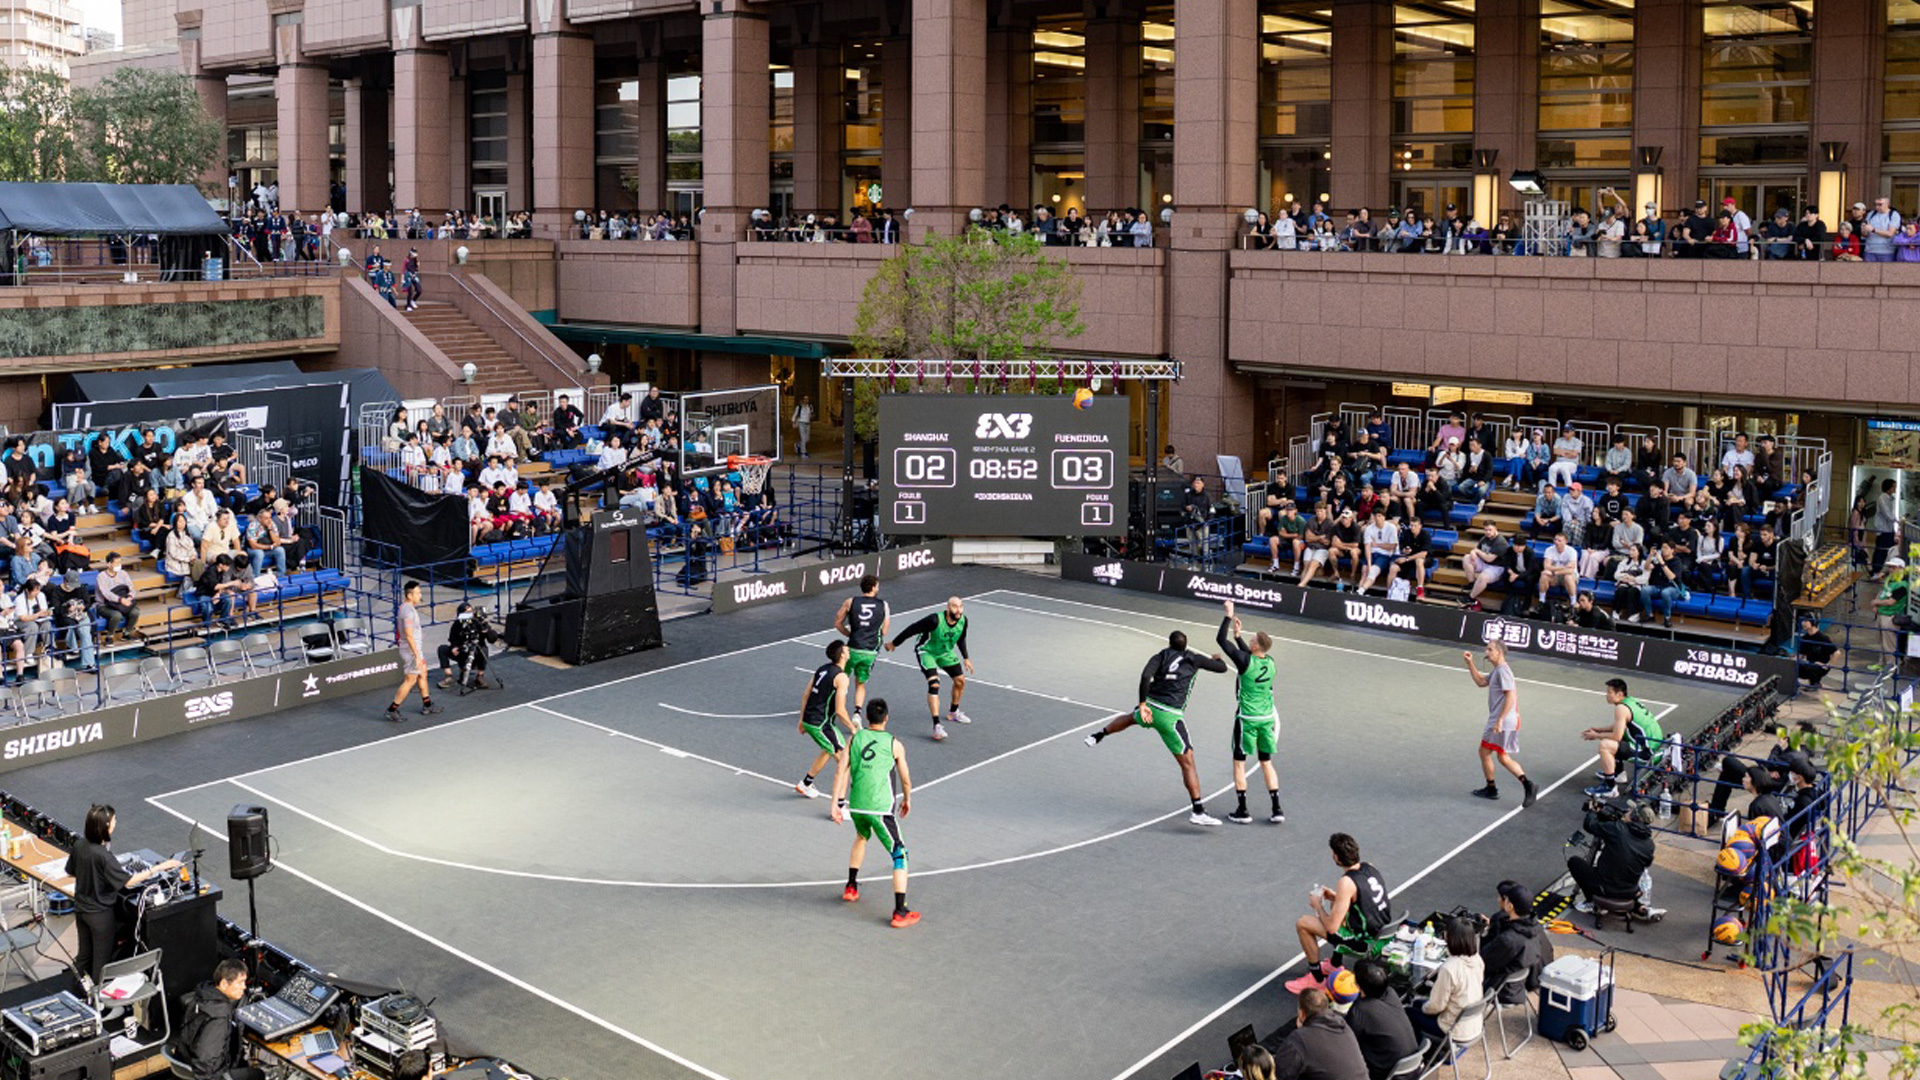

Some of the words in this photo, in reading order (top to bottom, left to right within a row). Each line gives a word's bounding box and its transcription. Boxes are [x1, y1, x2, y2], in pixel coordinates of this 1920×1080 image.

[704, 400, 758, 418] SHIBUYA
[903, 432, 950, 442] SHANGHAI
[1054, 433, 1109, 443] FUENGIROLA
[905, 455, 946, 480] 02
[970, 458, 1038, 480] 08:52
[1062, 456, 1103, 482] 03
[904, 505, 915, 520] 1
[1091, 506, 1102, 521] 1
[898, 549, 935, 570] BIGC.
[830, 563, 865, 584] PLCO
[733, 580, 788, 603] Wilson
[1187, 575, 1233, 595] Avant
[1235, 583, 1283, 603] Sports
[858, 603, 876, 620] 5
[1344, 600, 1419, 630] Wilson
[1556, 630, 1577, 643] 日本
[1578, 634, 1618, 650] ボラセン
[1168, 656, 1184, 673] 6
[1254, 665, 1271, 683] 2
[1673, 660, 1759, 686] @FIBA3x3
[3, 722, 104, 760] SHIBUYA
[861, 740, 878, 761] 6
